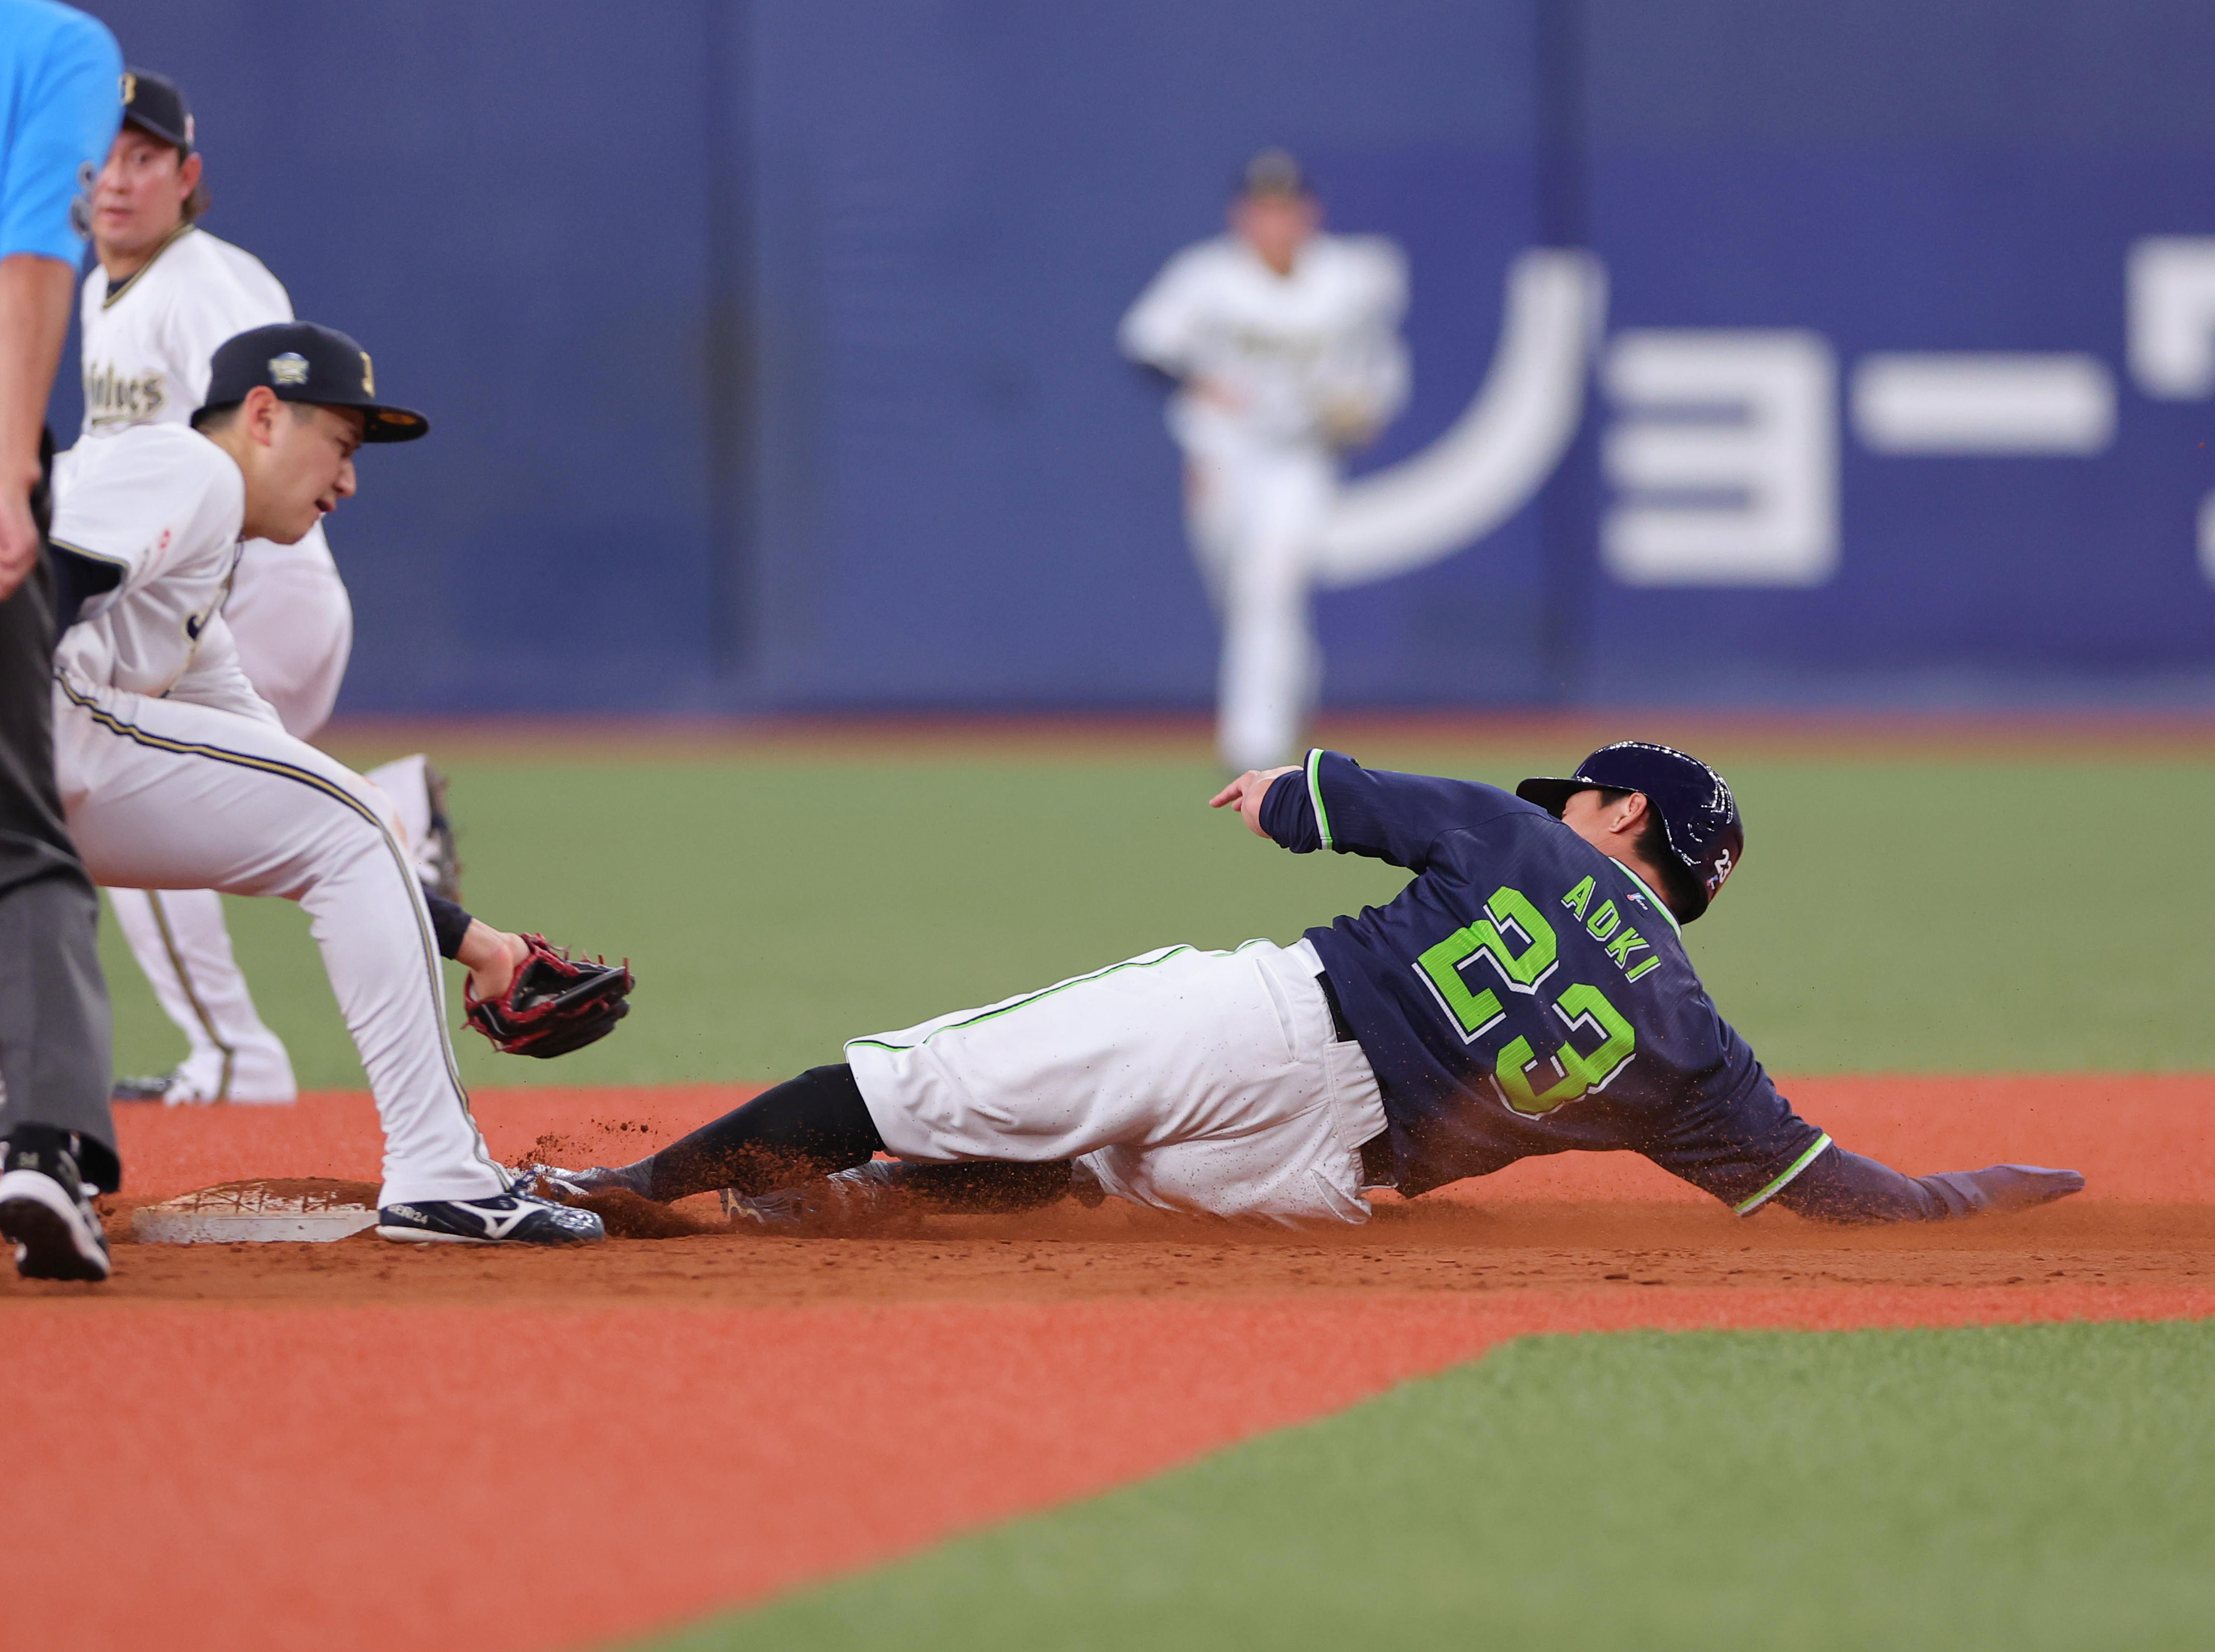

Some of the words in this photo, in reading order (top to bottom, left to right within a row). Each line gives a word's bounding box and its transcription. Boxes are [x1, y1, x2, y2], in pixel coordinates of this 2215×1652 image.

[1714, 848, 1732, 883] 23
[1561, 875, 1661, 983] AOKI
[1412, 886, 1636, 1120] 23
